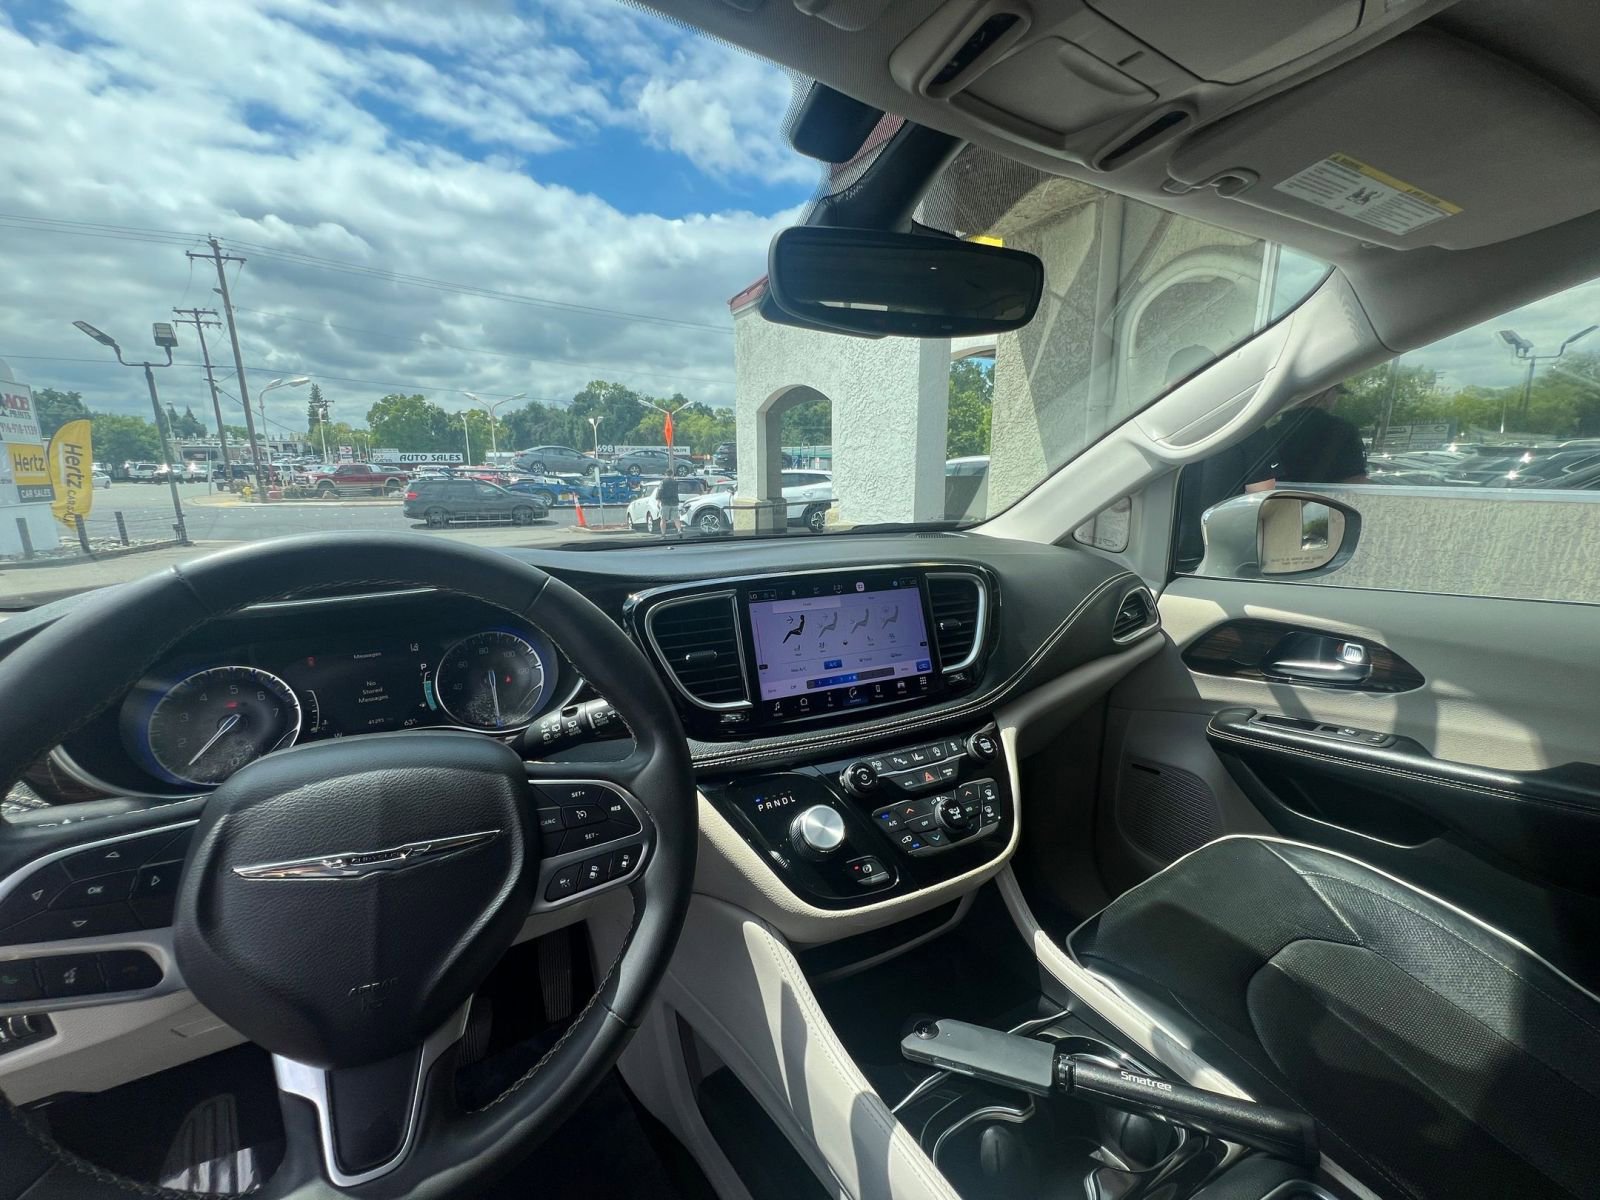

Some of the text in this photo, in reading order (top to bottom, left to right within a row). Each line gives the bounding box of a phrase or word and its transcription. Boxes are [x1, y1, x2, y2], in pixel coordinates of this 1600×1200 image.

[597, 444, 614, 453] 698
[13, 453, 46, 472] Hertz
[399, 454, 427, 462] AUTO
[64, 443, 85, 489] Hertz
[21, 488, 52, 499] CAR SALES
[230, 684, 239, 695] 5
[362, 687, 383, 695] Stored
[199, 692, 208, 701] 4
[257, 691, 266, 701] 6
[358, 694, 389, 703] Messages
[272, 707, 280, 719] 7
[87, 886, 104, 895] OK
[1120, 1070, 1172, 1092] Smatree
